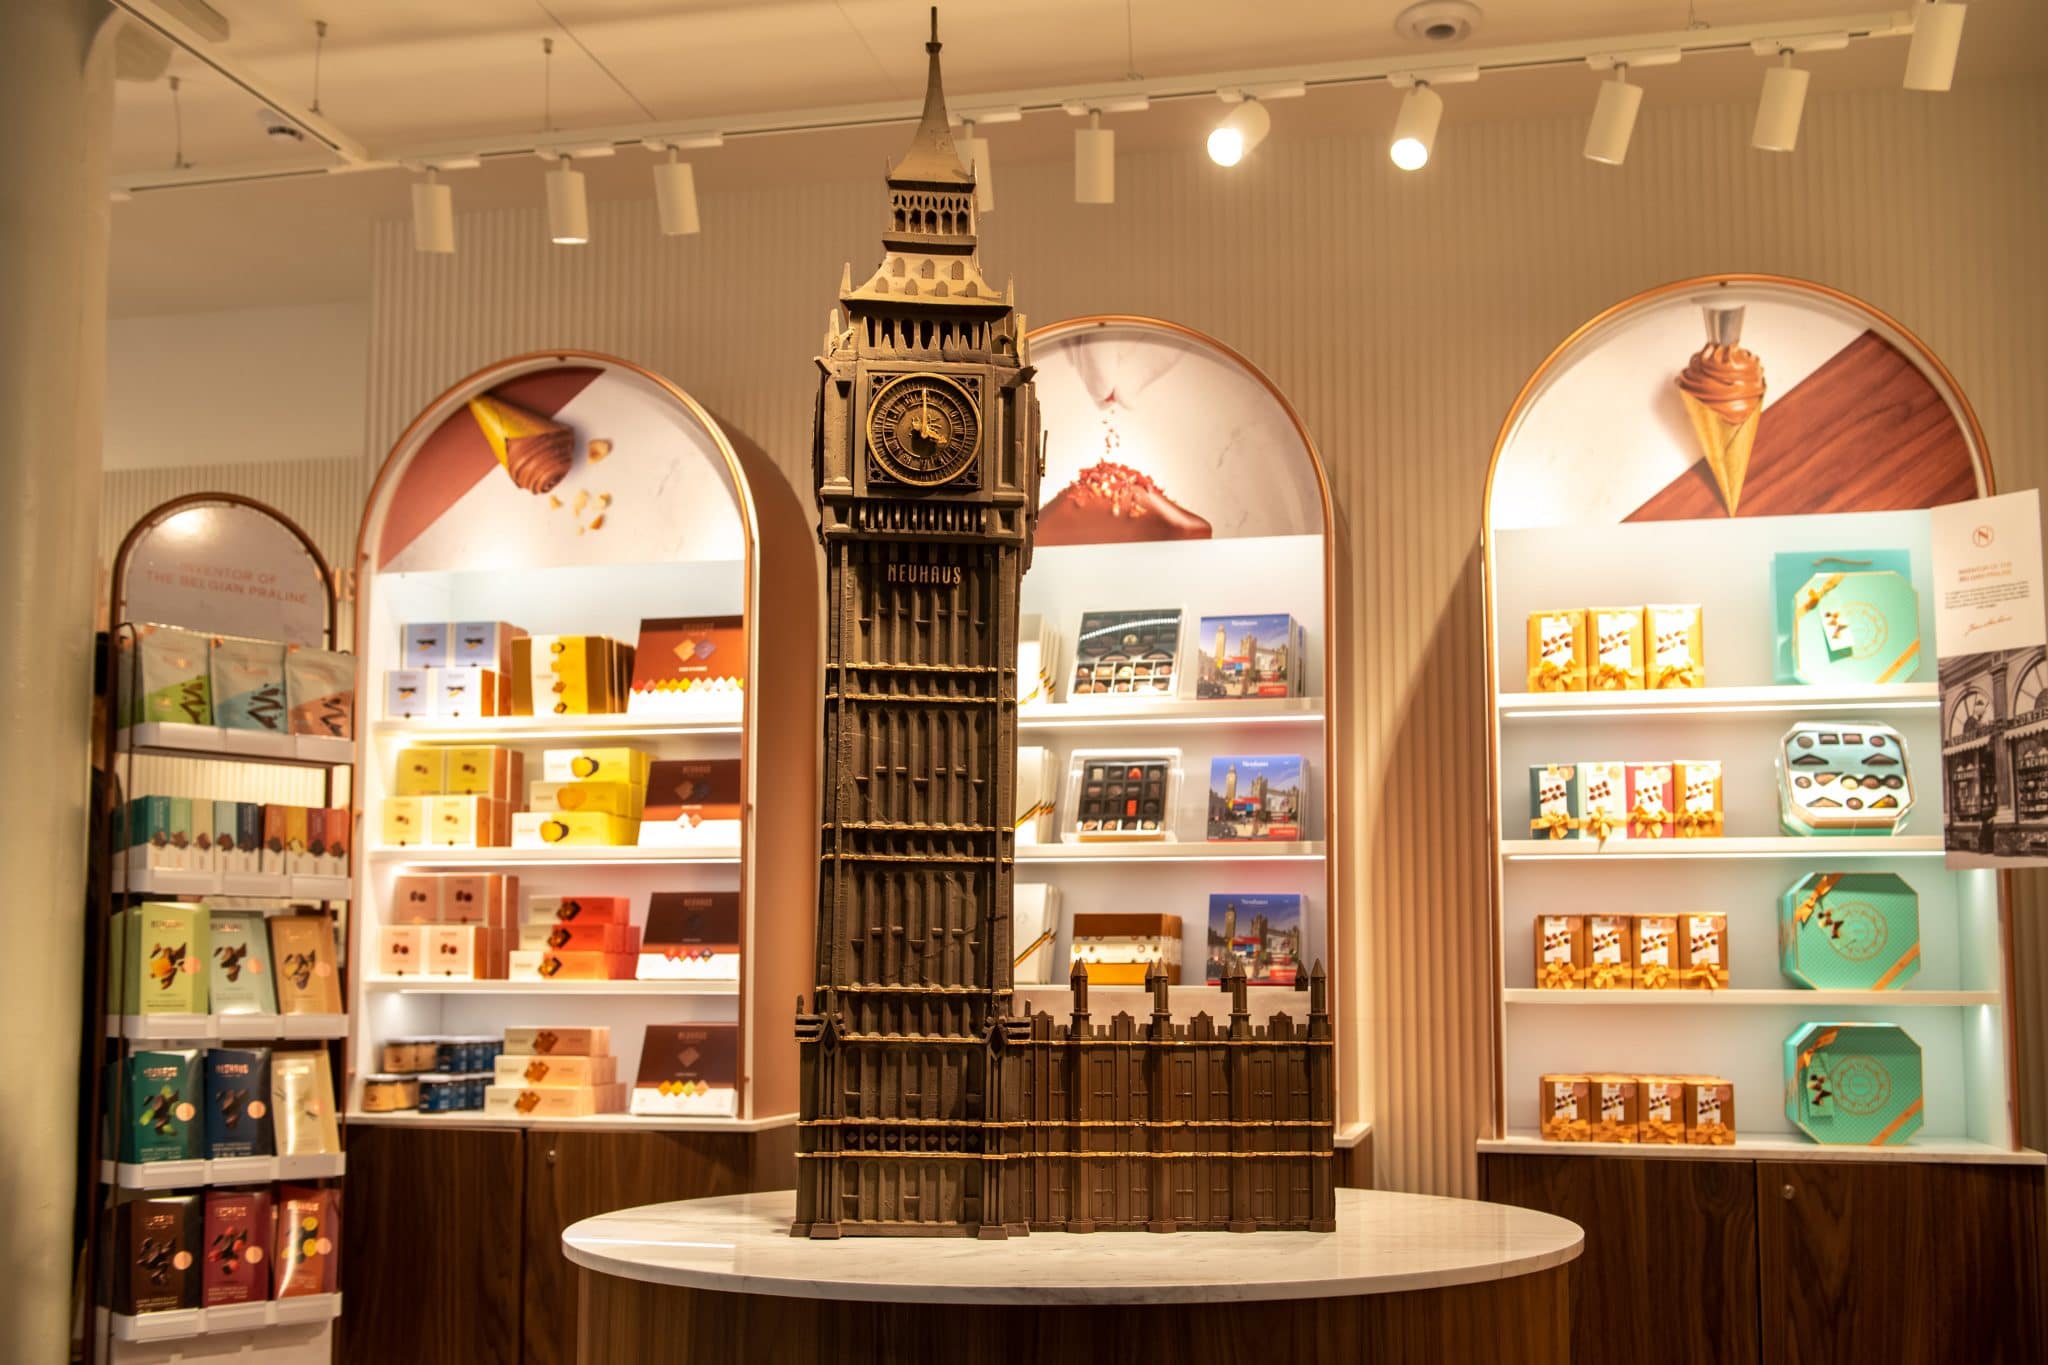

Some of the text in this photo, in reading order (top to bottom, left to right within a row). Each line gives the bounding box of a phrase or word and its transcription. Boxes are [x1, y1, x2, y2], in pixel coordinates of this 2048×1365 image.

[257, 572, 277, 585] OF
[887, 563, 961, 584] NEUHAUS
[147, 570, 307, 604] THE BELGIAN PRALINE
